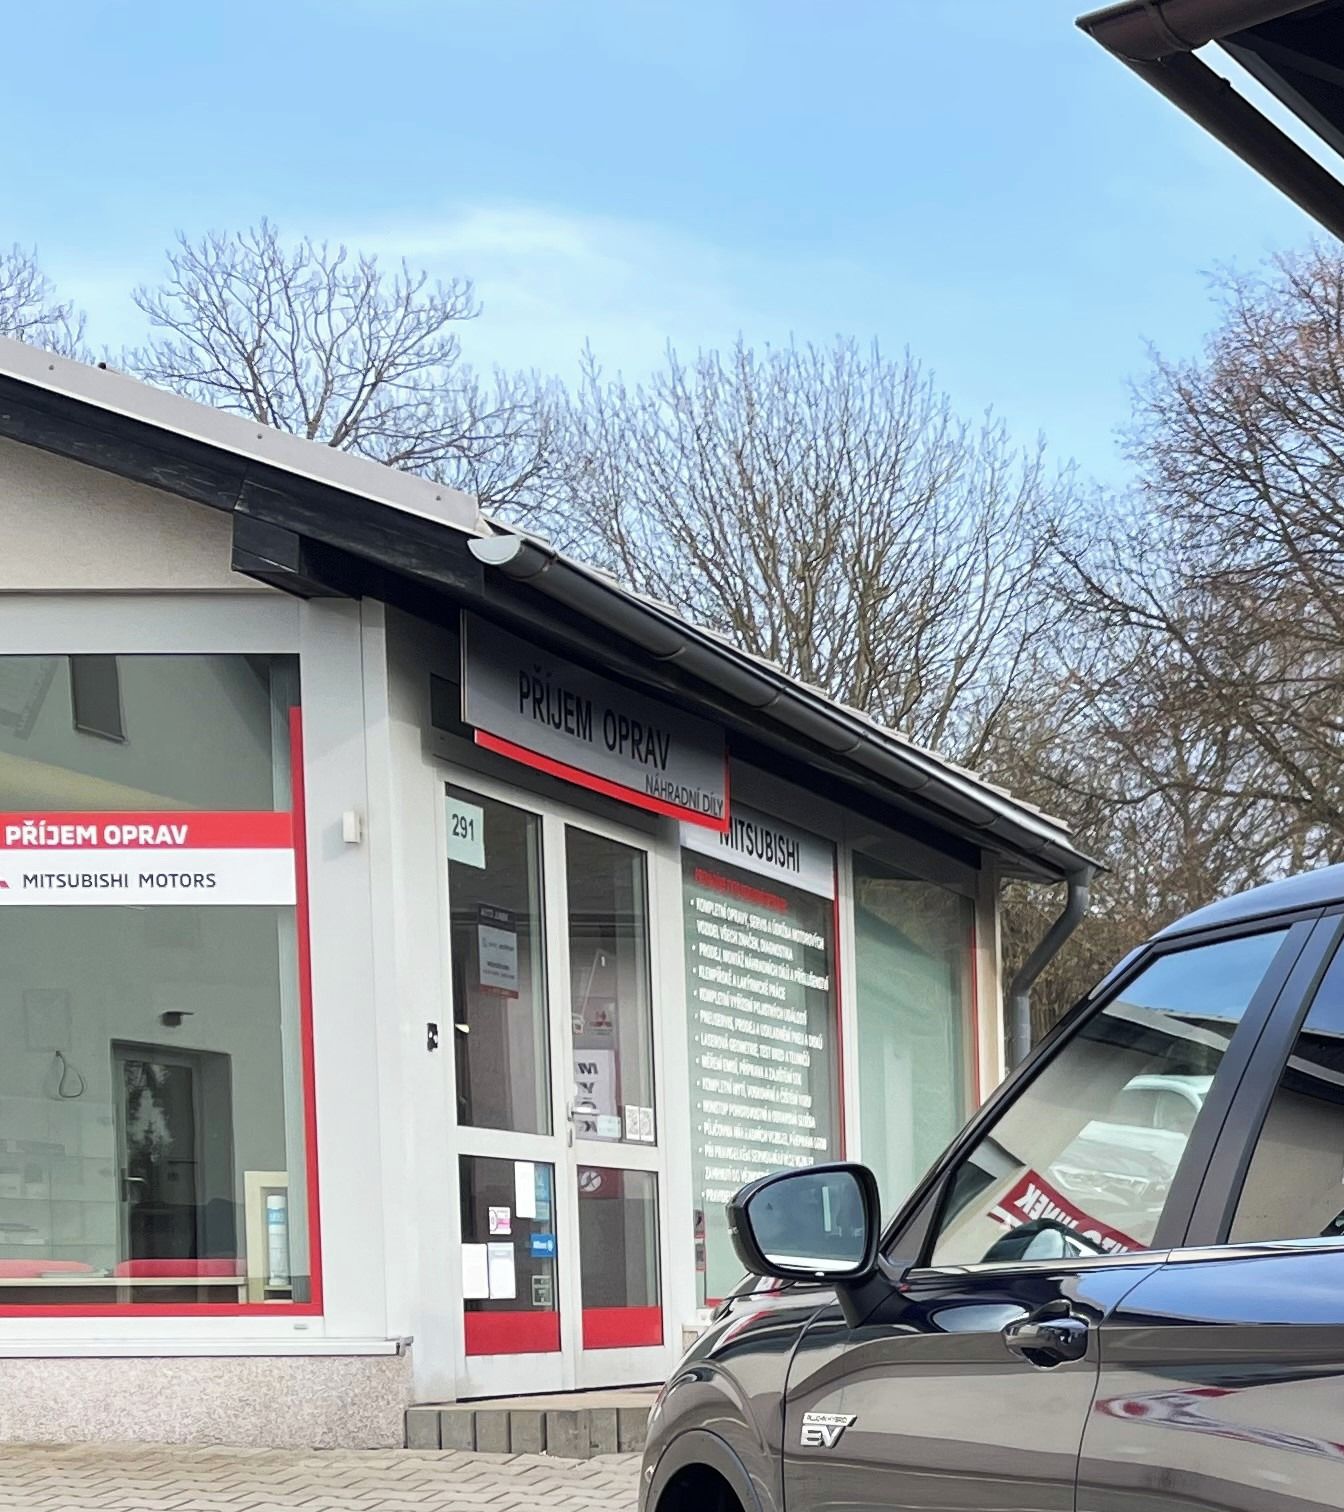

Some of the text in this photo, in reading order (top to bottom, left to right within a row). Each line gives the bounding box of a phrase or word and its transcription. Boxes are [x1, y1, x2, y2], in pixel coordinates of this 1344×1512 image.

[518, 664, 671, 771] PŘÍJEM OPRAV
[645, 774, 724, 818] NÁHRADNÍ DÍLY
[5, 820, 189, 846] PŘÍJEM OPRAV
[452, 813, 475, 842] 291
[719, 815, 800, 874] MITSUBISHI
[22, 873, 216, 889] MITSUBISHI MOTORS
[800, 1425, 846, 1449] EV
